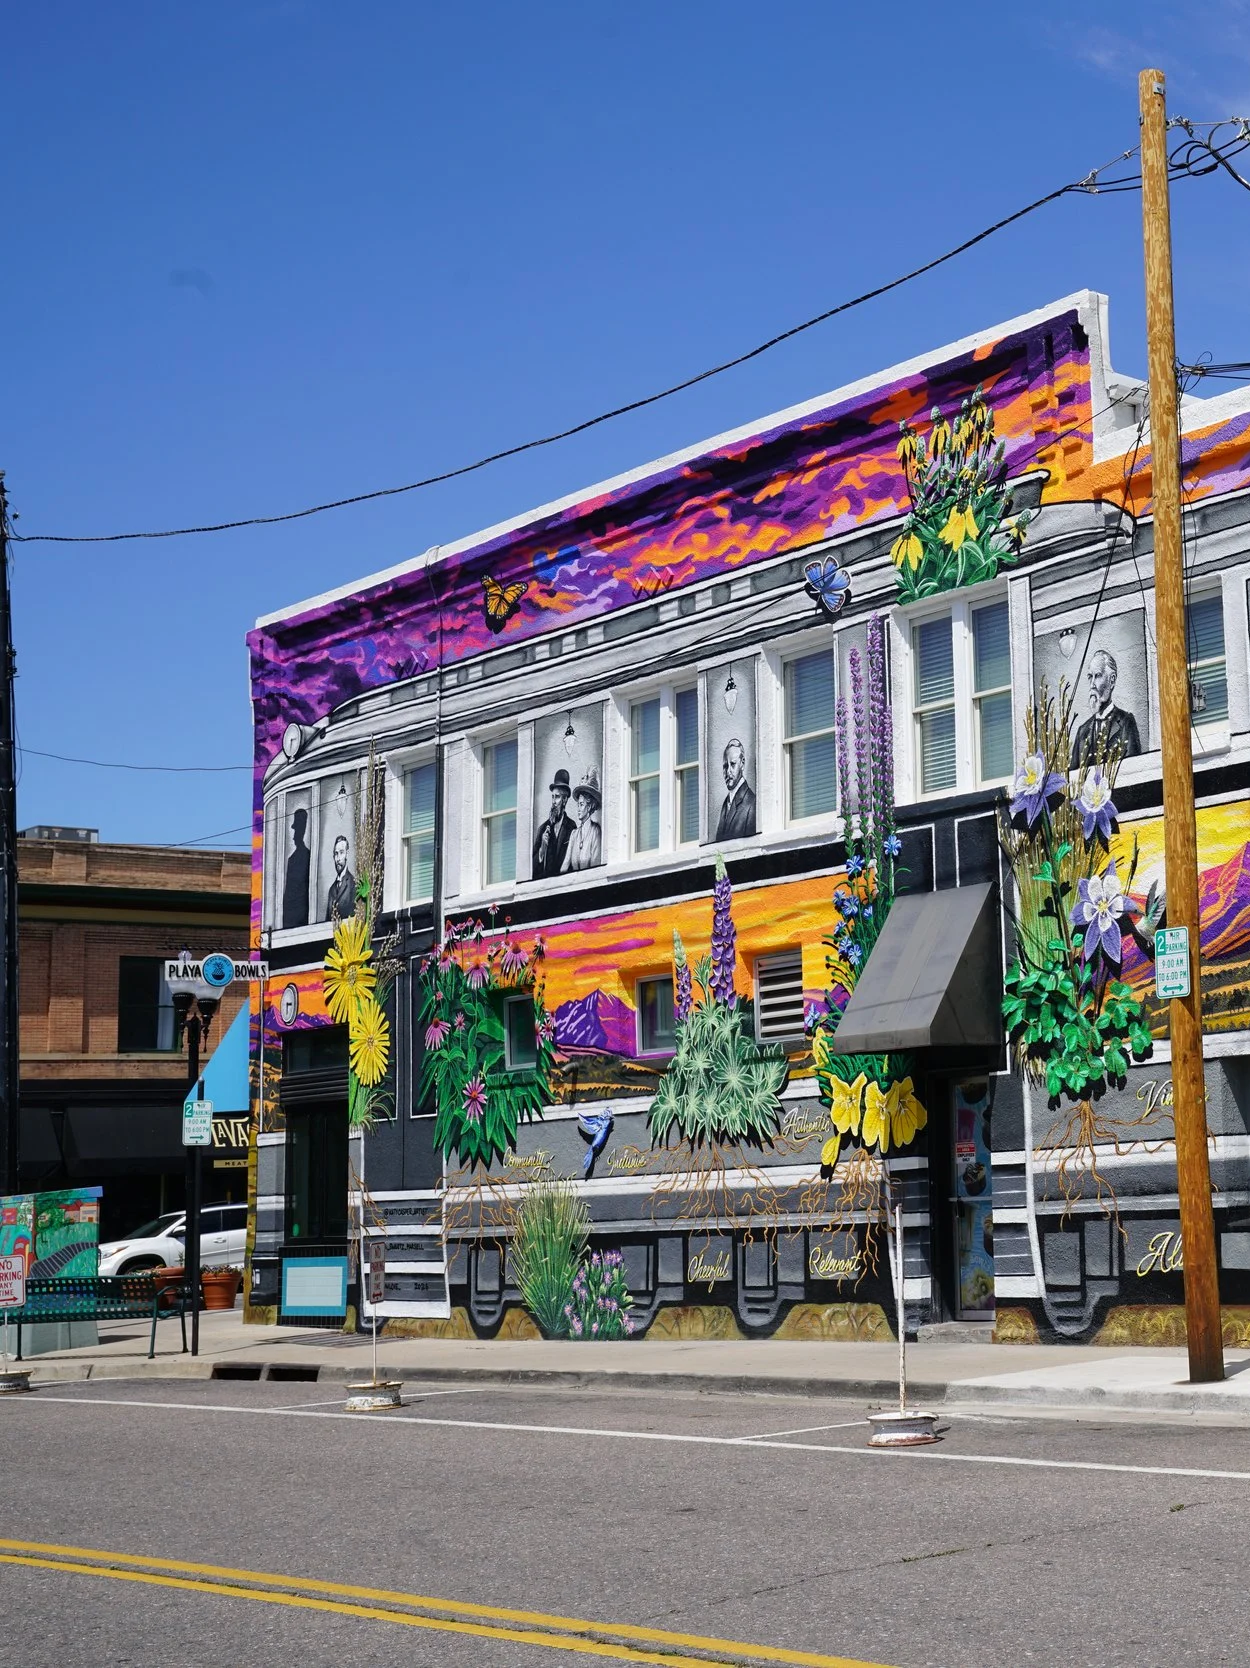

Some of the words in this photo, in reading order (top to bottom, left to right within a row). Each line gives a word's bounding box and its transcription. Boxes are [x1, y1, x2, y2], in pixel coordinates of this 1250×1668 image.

[1157, 935, 1165, 952] 2
[1172, 931, 1180, 940] HR
[1166, 942, 1187, 952] PARKING
[1176, 958, 1184, 966] AM
[168, 964, 202, 978] PLAYA
[234, 964, 267, 978] BOWLS
[1180, 970, 1187, 979] PM
[185, 1105, 193, 1116] 2
[781, 1107, 830, 1142] Authentic
[503, 1146, 551, 1180] Community
[607, 1148, 647, 1176] Inclusive
[0, 1260, 12, 1270] NO
[809, 1246, 862, 1279] Relevant
[0, 1271, 22, 1281] RKING
[687, 1250, 730, 1294] Cheerful
